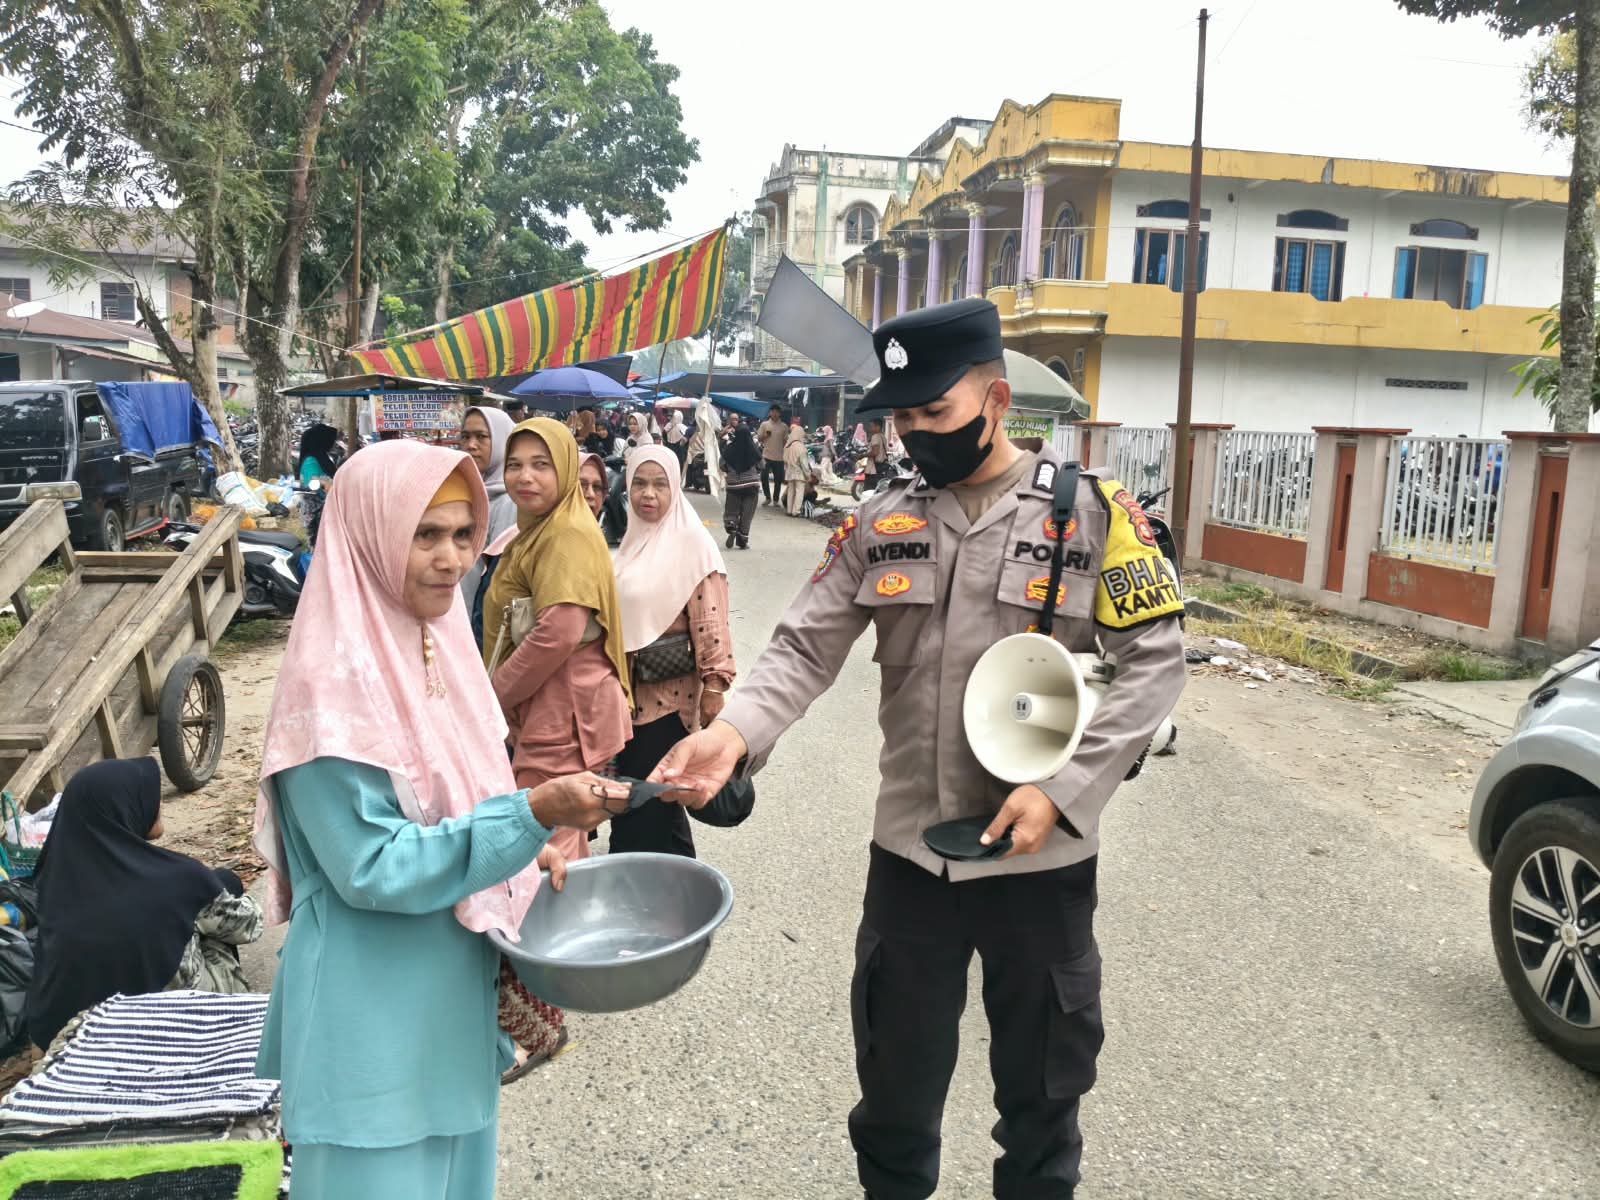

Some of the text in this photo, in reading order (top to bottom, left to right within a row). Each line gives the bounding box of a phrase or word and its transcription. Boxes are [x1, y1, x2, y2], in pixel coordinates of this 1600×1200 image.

[383, 394, 406, 402] SOSIS
[384, 412, 409, 420] TELUR
[384, 421, 405, 429] OTAK
